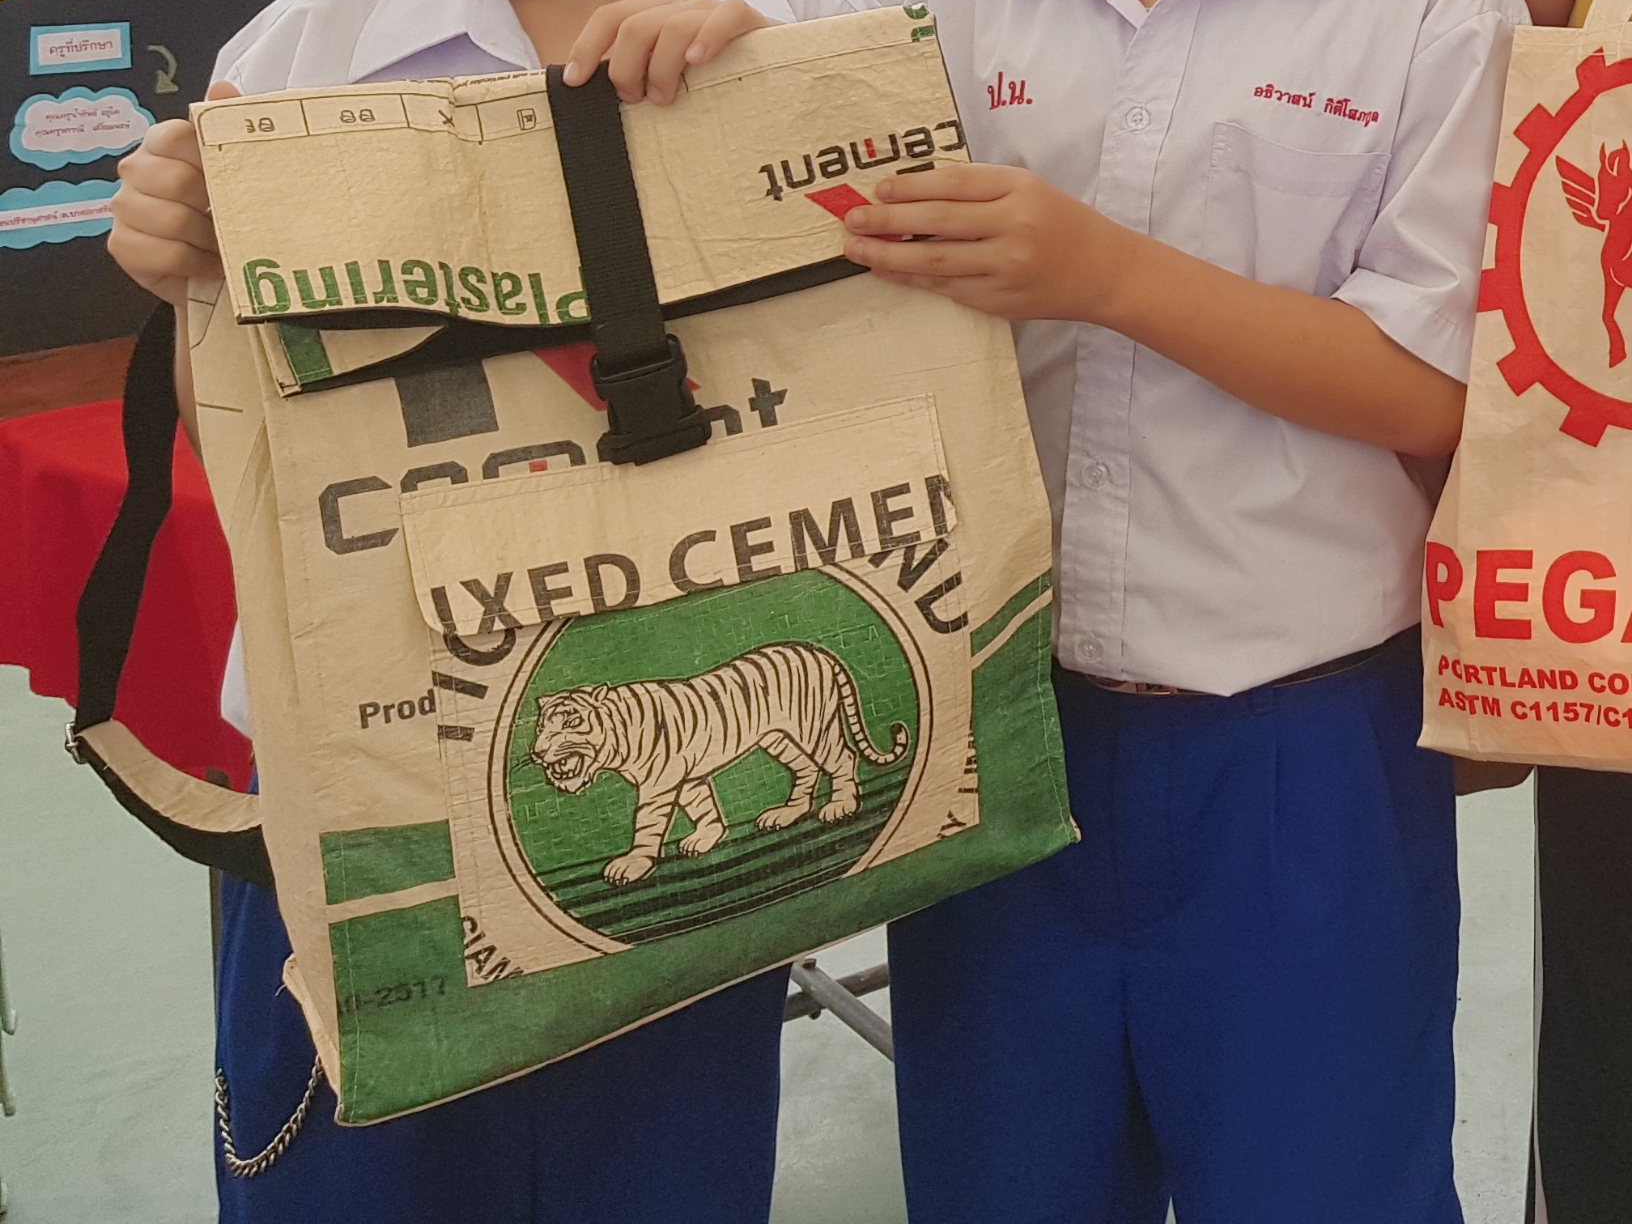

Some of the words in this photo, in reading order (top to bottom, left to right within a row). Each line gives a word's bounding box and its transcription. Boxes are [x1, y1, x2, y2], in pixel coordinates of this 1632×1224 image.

[49, 38, 114, 58] ครูที่ปรึกษา
[987, 70, 1034, 111] ป.น.
[1253, 83, 1317, 109] อธิวาสน์
[757, 118, 967, 202] cement
[242, 256, 591, 326] Plastering
[1438, 653, 1580, 692] PORTLAND
[1438, 685, 1503, 718] ASTM
